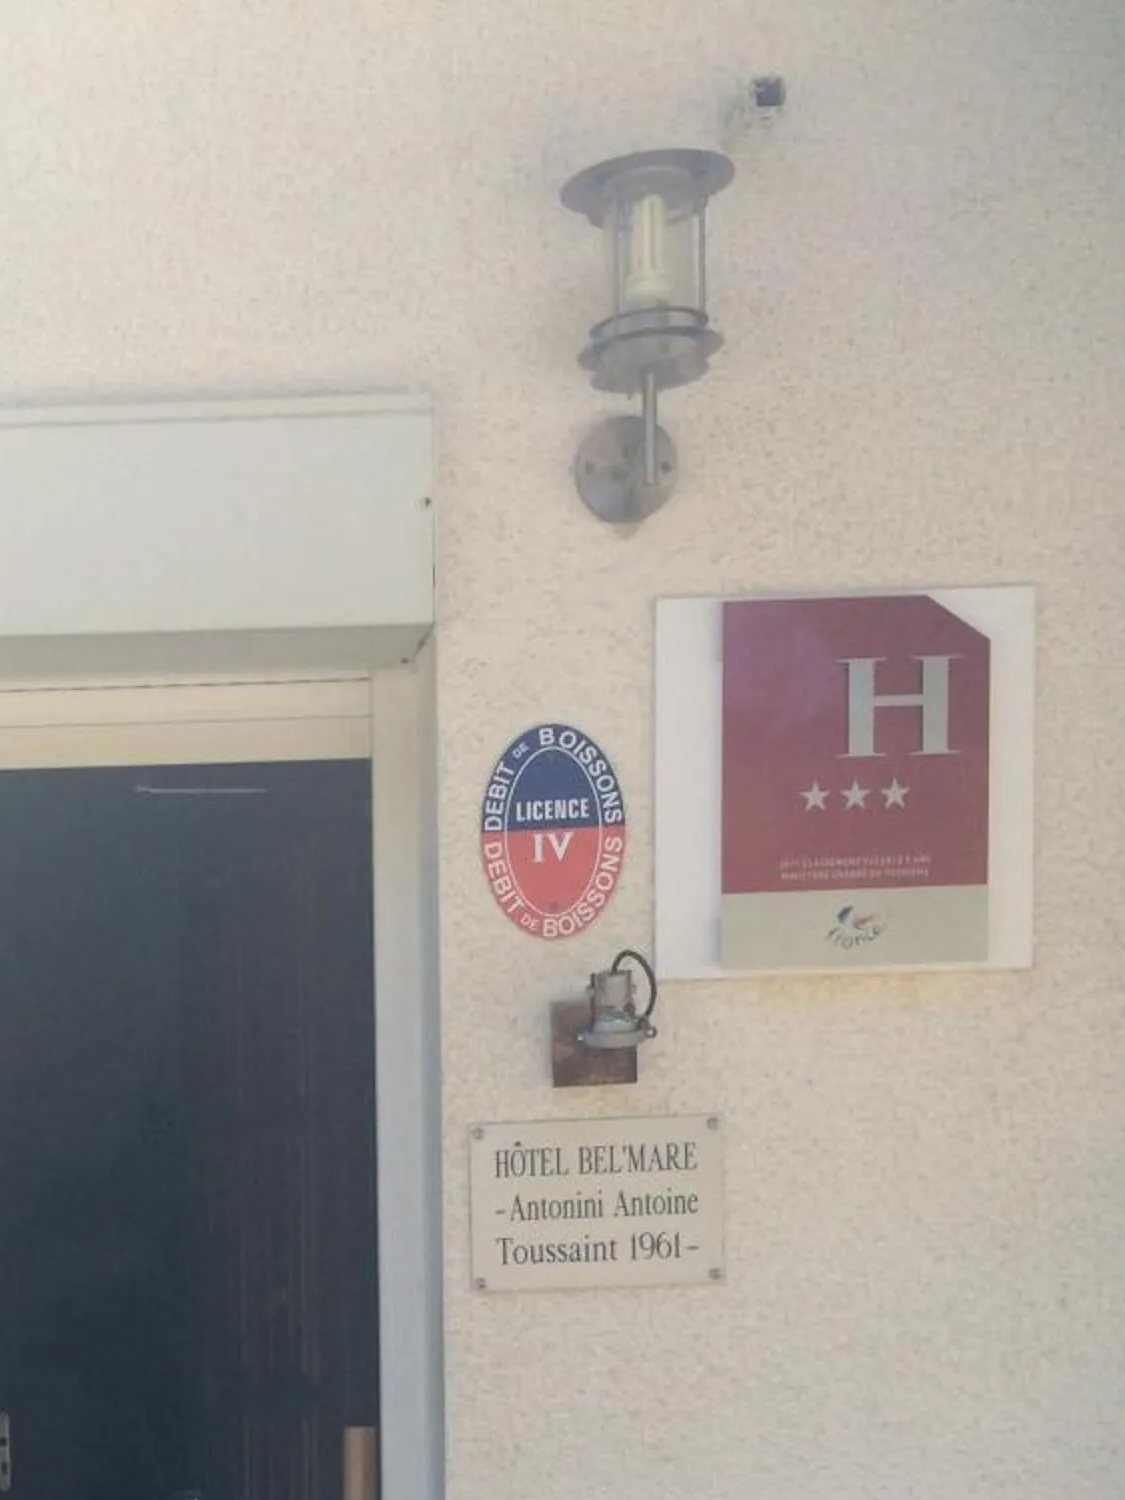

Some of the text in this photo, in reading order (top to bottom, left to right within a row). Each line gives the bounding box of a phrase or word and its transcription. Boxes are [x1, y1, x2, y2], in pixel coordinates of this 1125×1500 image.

[837, 654, 965, 759] H
[484, 762, 514, 832] DEBIT
[539, 727, 622, 823] BOISSONS
[516, 797, 590, 822] LICENCE
[532, 831, 574, 864] IV
[484, 841, 525, 914] DEBIT
[542, 836, 622, 938] BOISSONS
[494, 1140, 698, 1179] HÔTEL BEL'MARE
[613, 1187, 699, 1217] Antoine
[495, 1234, 618, 1266] Toussaint
